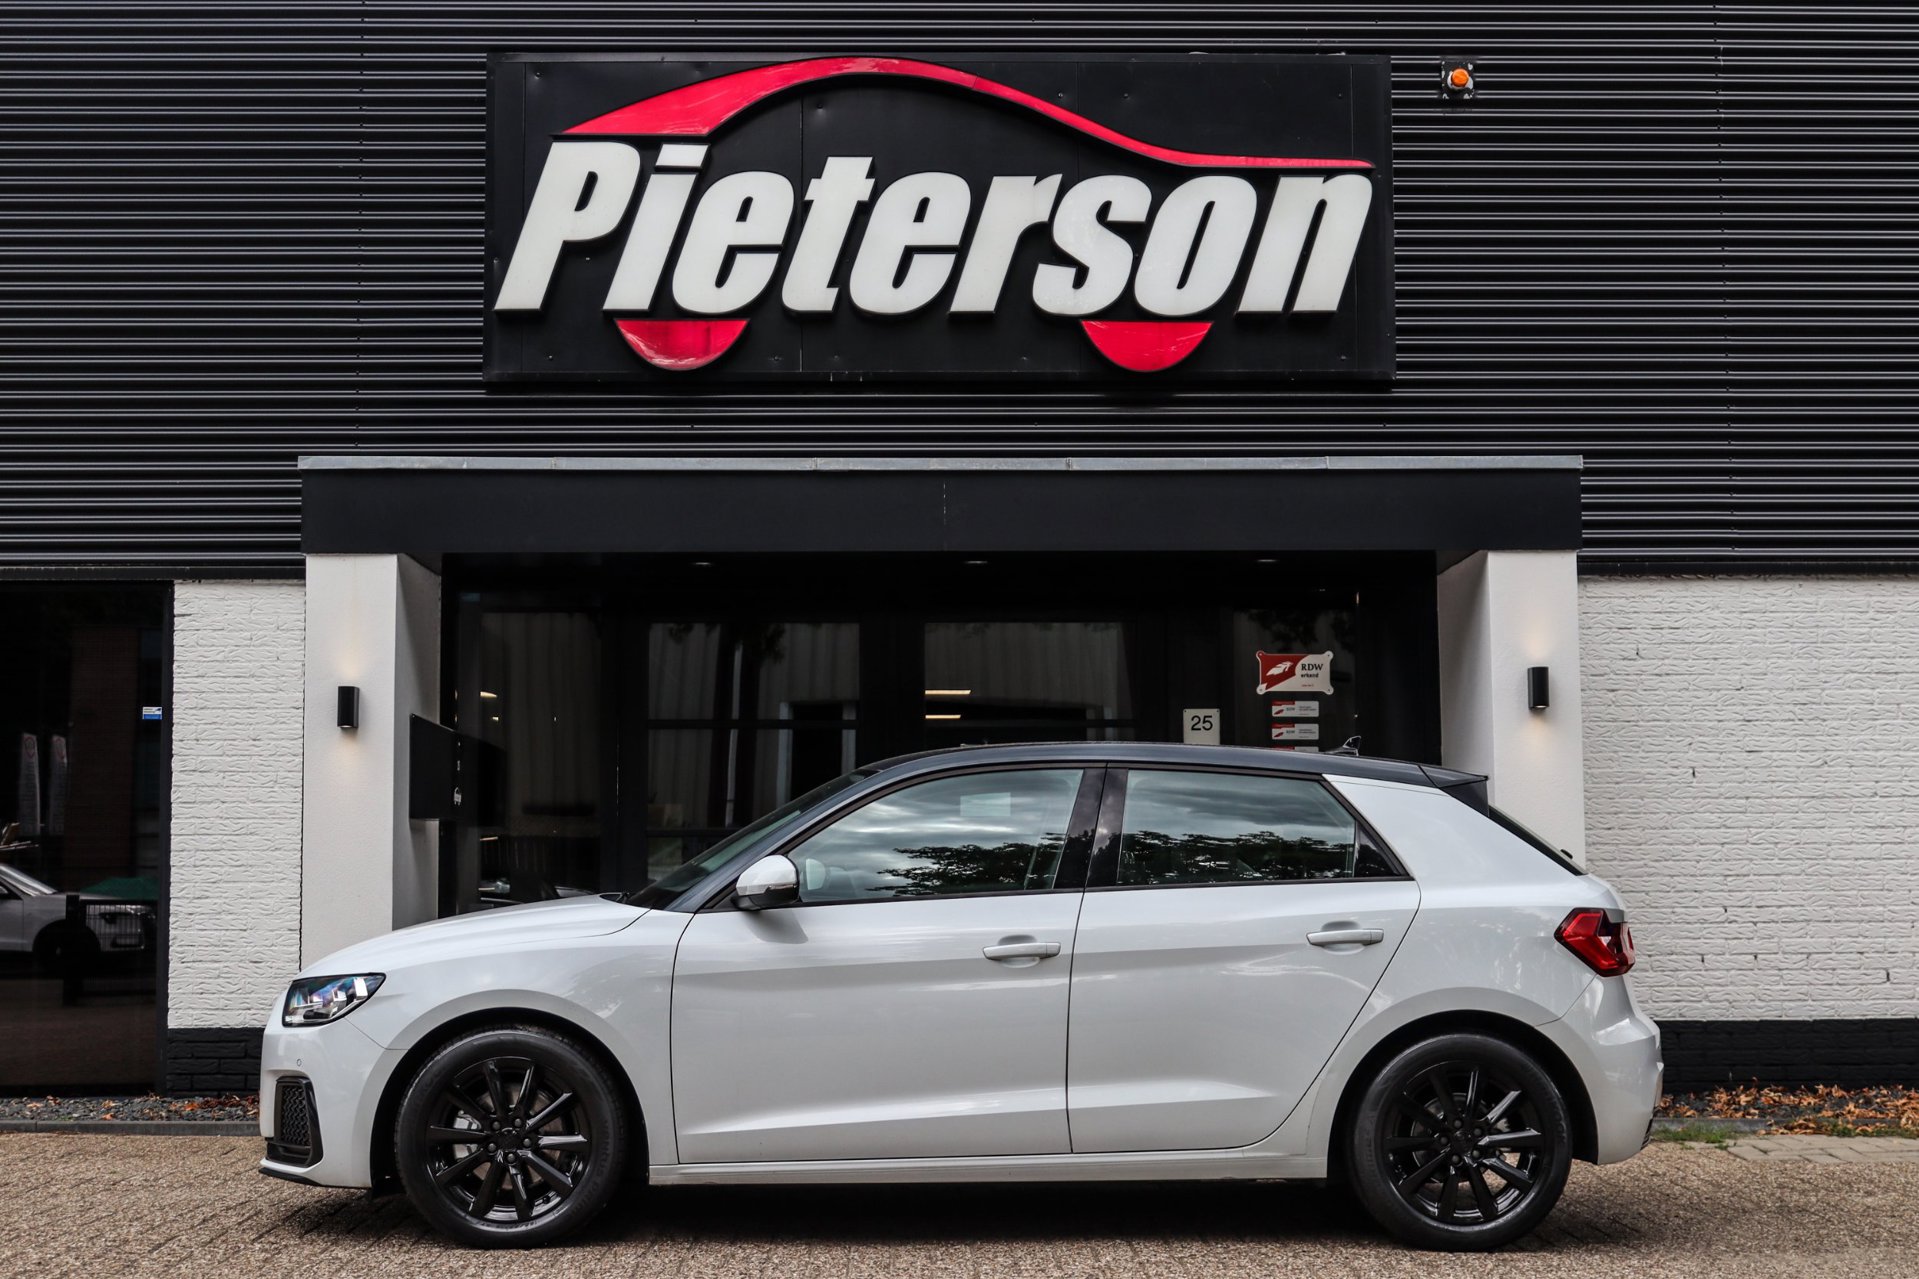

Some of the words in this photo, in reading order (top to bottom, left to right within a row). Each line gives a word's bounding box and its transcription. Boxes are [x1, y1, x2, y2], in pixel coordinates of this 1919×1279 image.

[494, 142, 1373, 317] Pieterson
[1300, 663, 1324, 671] RDW
[1190, 714, 1213, 731] 25
